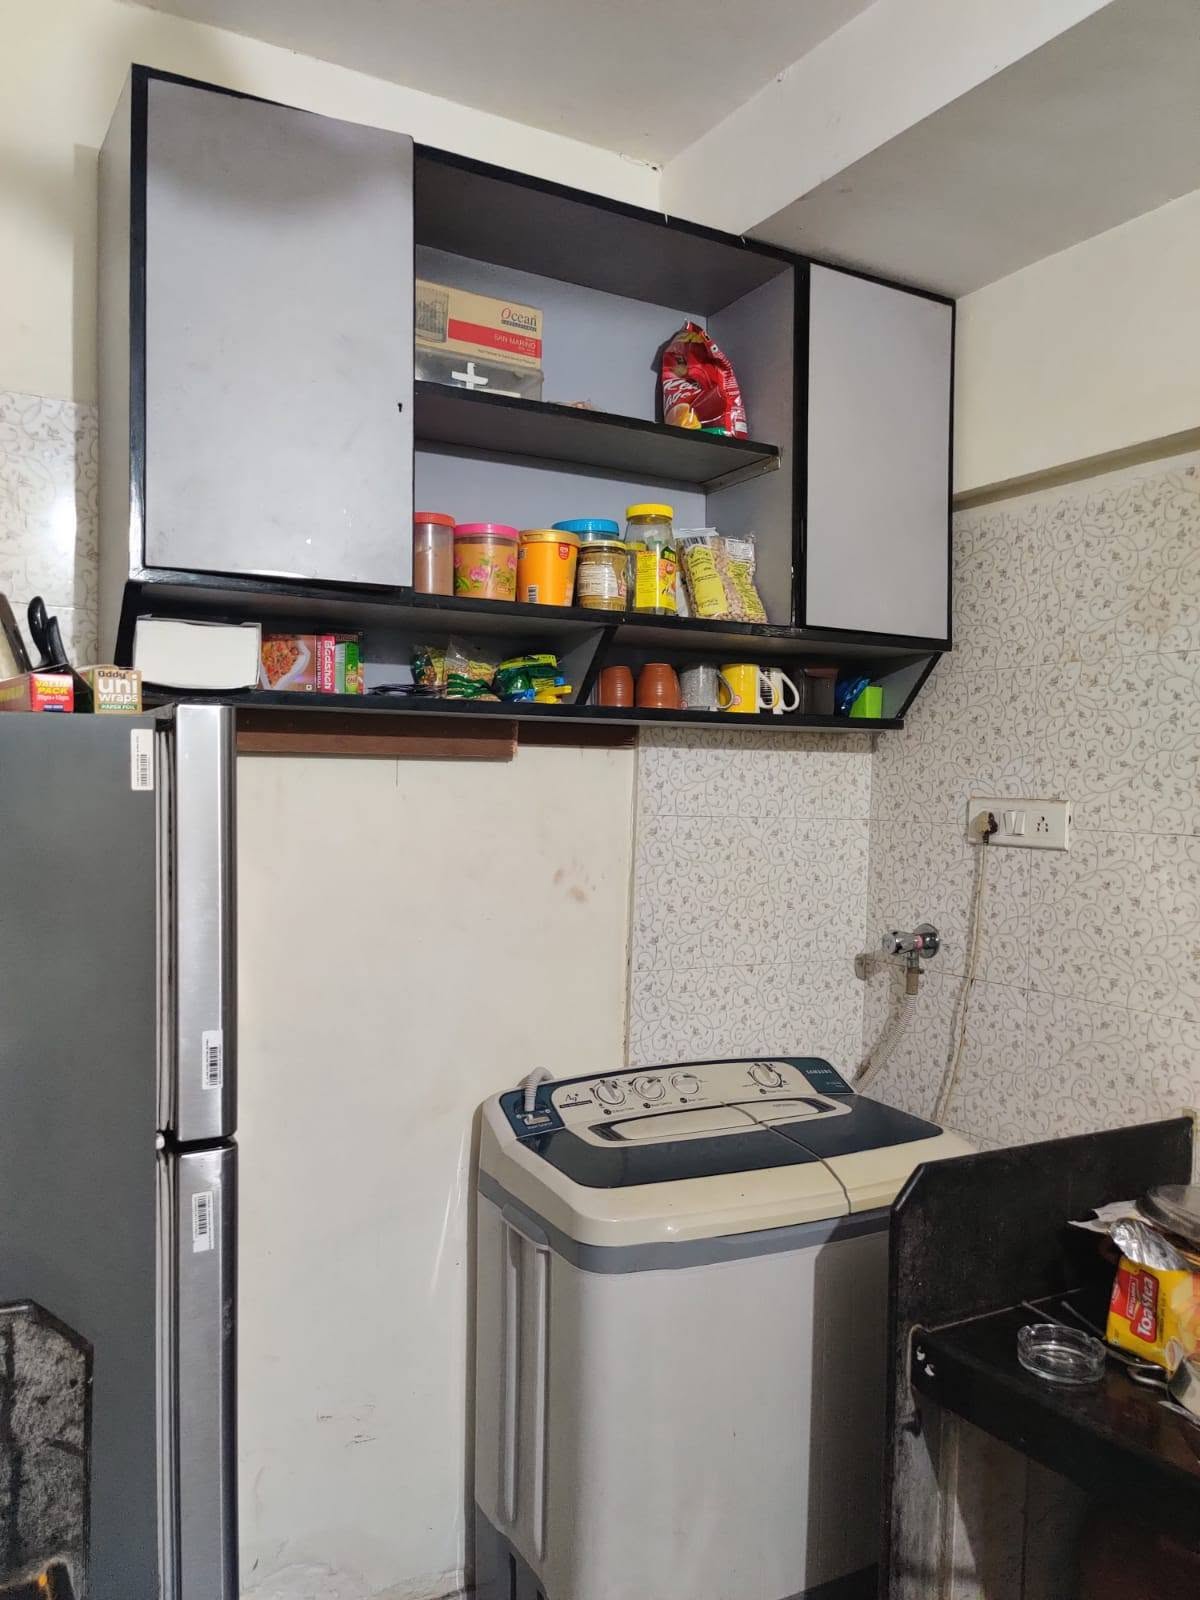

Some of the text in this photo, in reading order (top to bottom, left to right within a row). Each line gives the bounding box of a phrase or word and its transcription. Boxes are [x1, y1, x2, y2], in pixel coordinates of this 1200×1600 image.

[501, 307, 537, 327] Ocean
[37, 687, 69, 695] PACK
[98, 675, 138, 694] uni
[98, 693, 138, 705] wraps
